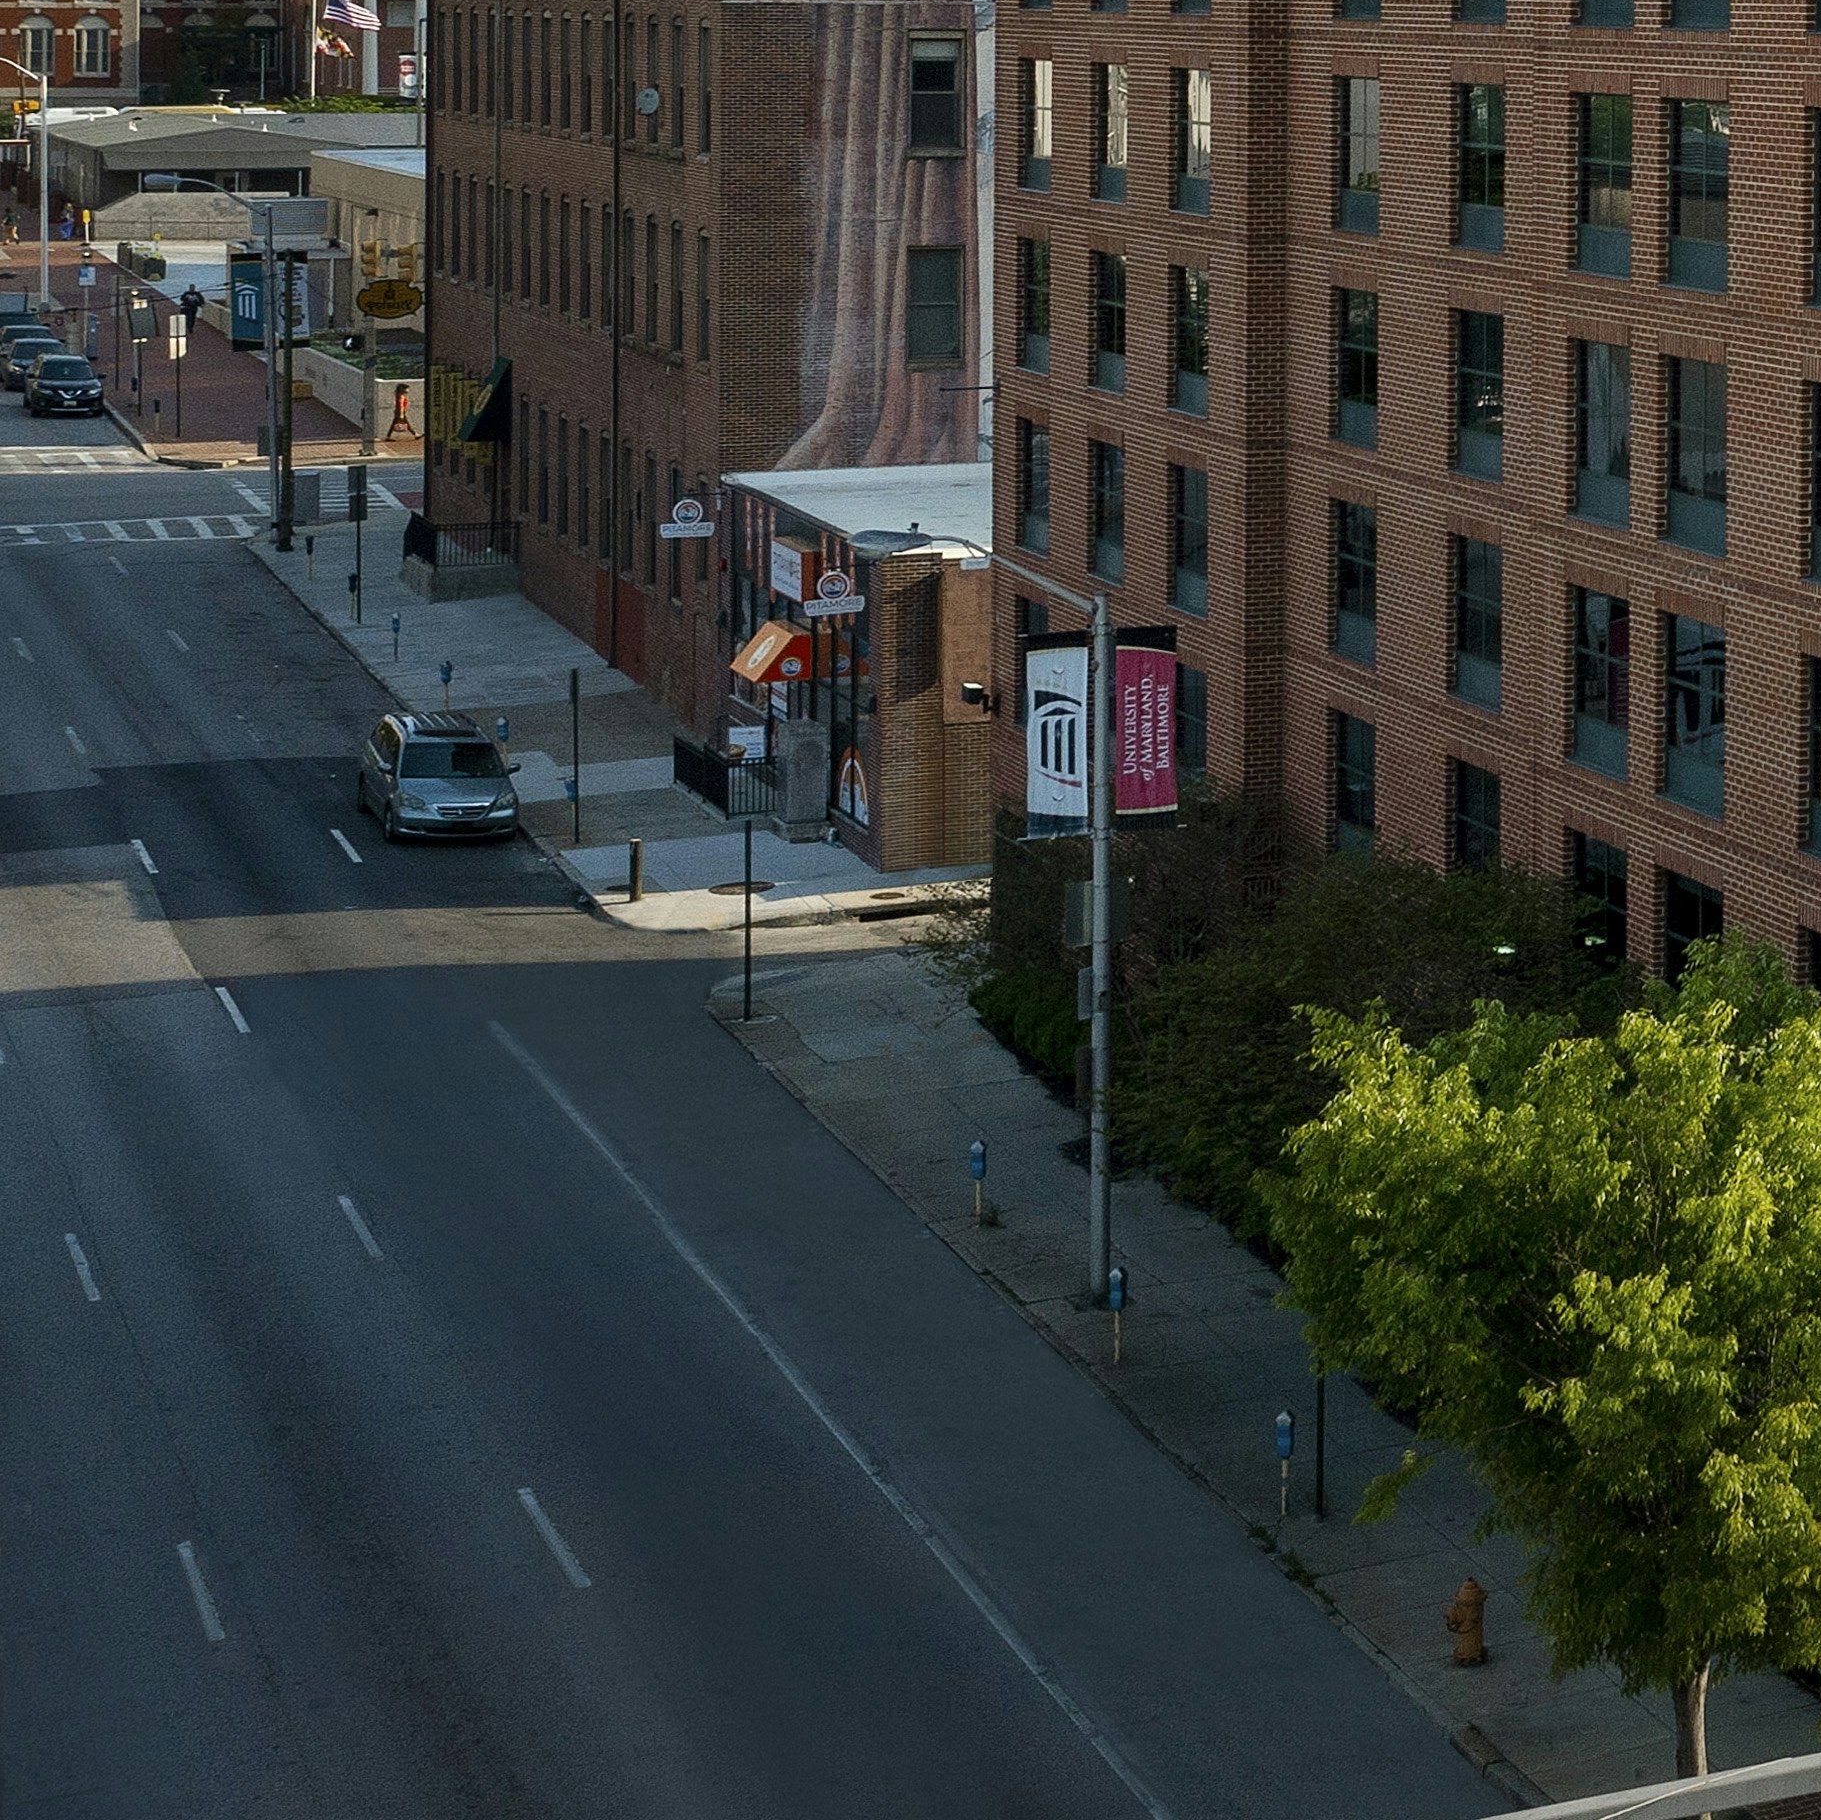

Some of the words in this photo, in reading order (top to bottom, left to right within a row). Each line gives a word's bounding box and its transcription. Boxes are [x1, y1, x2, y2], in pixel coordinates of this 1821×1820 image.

[806, 596, 863, 611] PITAMORE
[1123, 684, 1137, 775] UNIVERSITY
[1156, 684, 1170, 770] BALTIMORE
[1139, 765, 1155, 781] of
